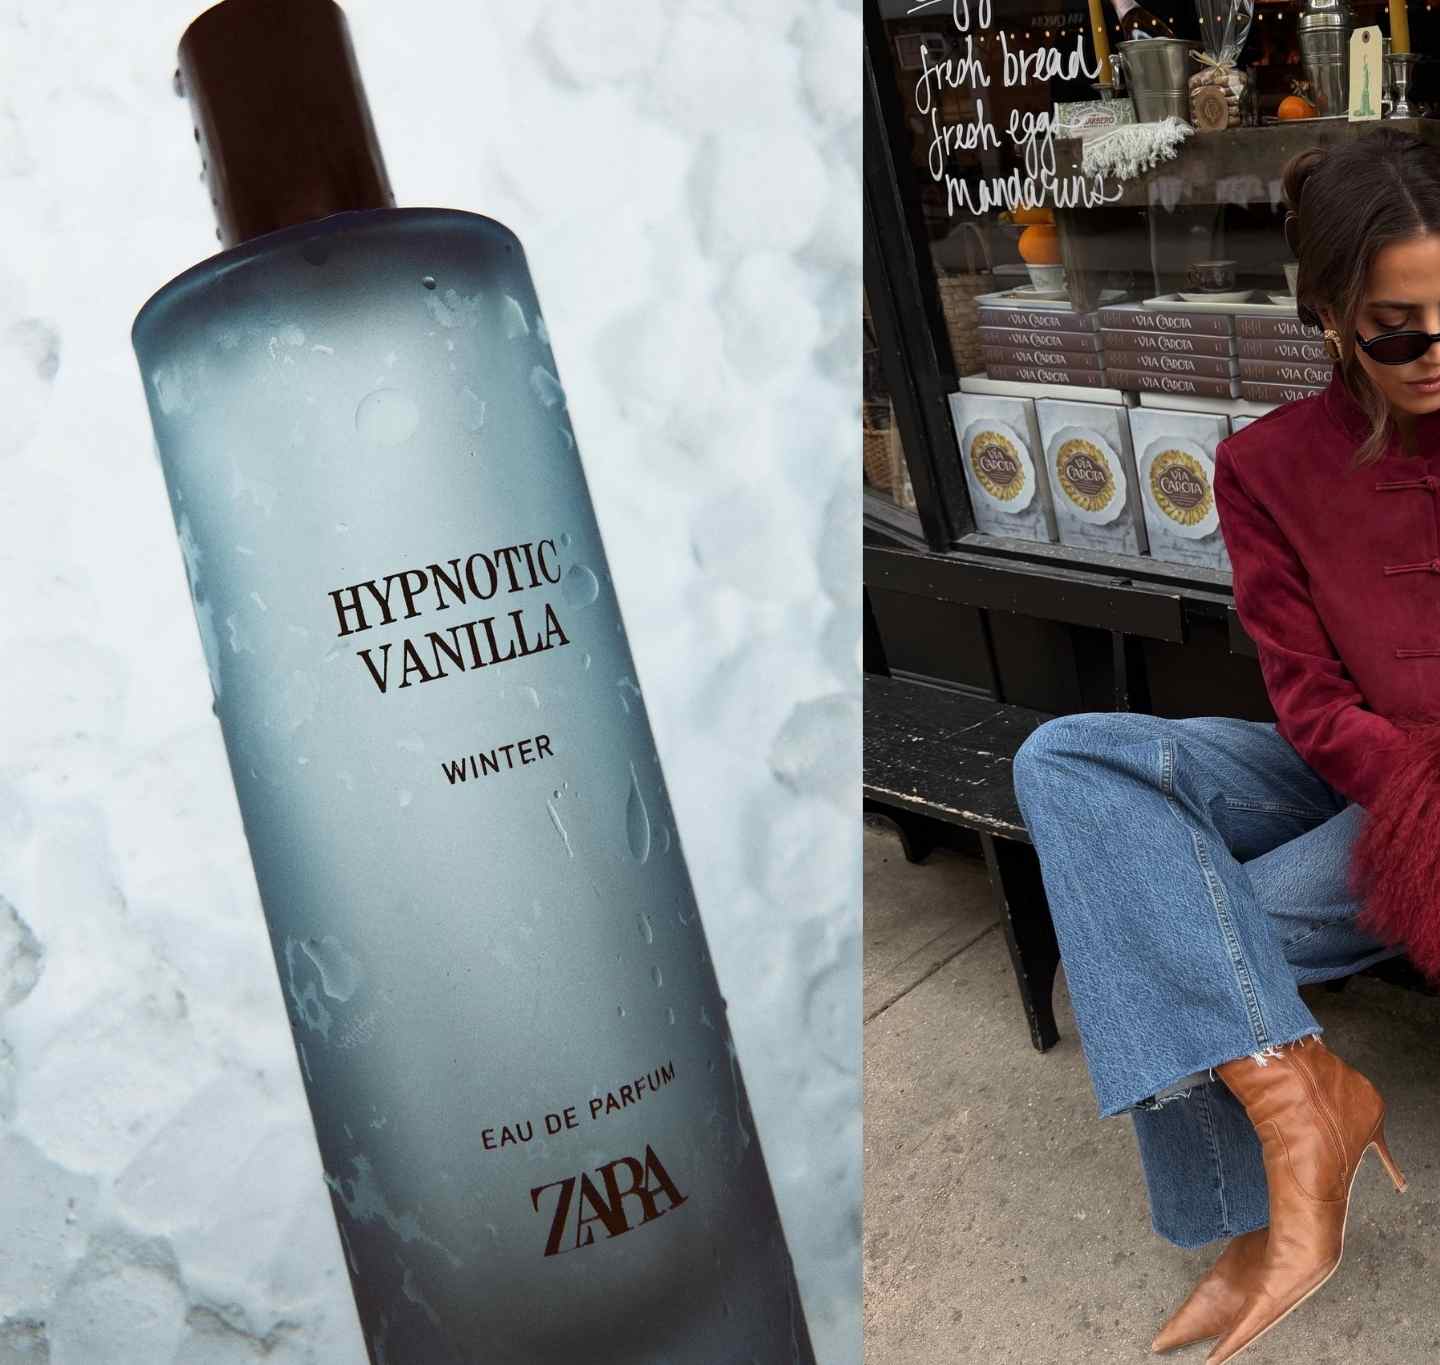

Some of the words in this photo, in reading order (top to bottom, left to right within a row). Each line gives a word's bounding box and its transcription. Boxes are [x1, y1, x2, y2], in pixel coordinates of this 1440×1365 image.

[915, 34, 991, 115] fresh
[1000, 30, 1102, 87] bread
[928, 98, 1002, 182] fresh
[945, 166, 1123, 217] mandarins
[1278, 322, 1298, 336] VIA
[1279, 344, 1299, 357] VIA
[1281, 367, 1301, 380] VIA
[1304, 367, 1332, 383] CARO
[1066, 464, 1105, 481] CAROTA
[1075, 457, 1092, 470] VIA
[1160, 476, 1202, 495] CAROTA
[1171, 469, 1189, 482] VIA
[328, 539, 561, 637] HYPNOTIC
[356, 603, 570, 693] VANILLA
[441, 734, 554, 785] WINTER
[481, 1121, 533, 1150] EAU
[545, 1107, 579, 1135] DE
[589, 1060, 676, 1120] PARFUM
[530, 1143, 689, 1258] ZARA
